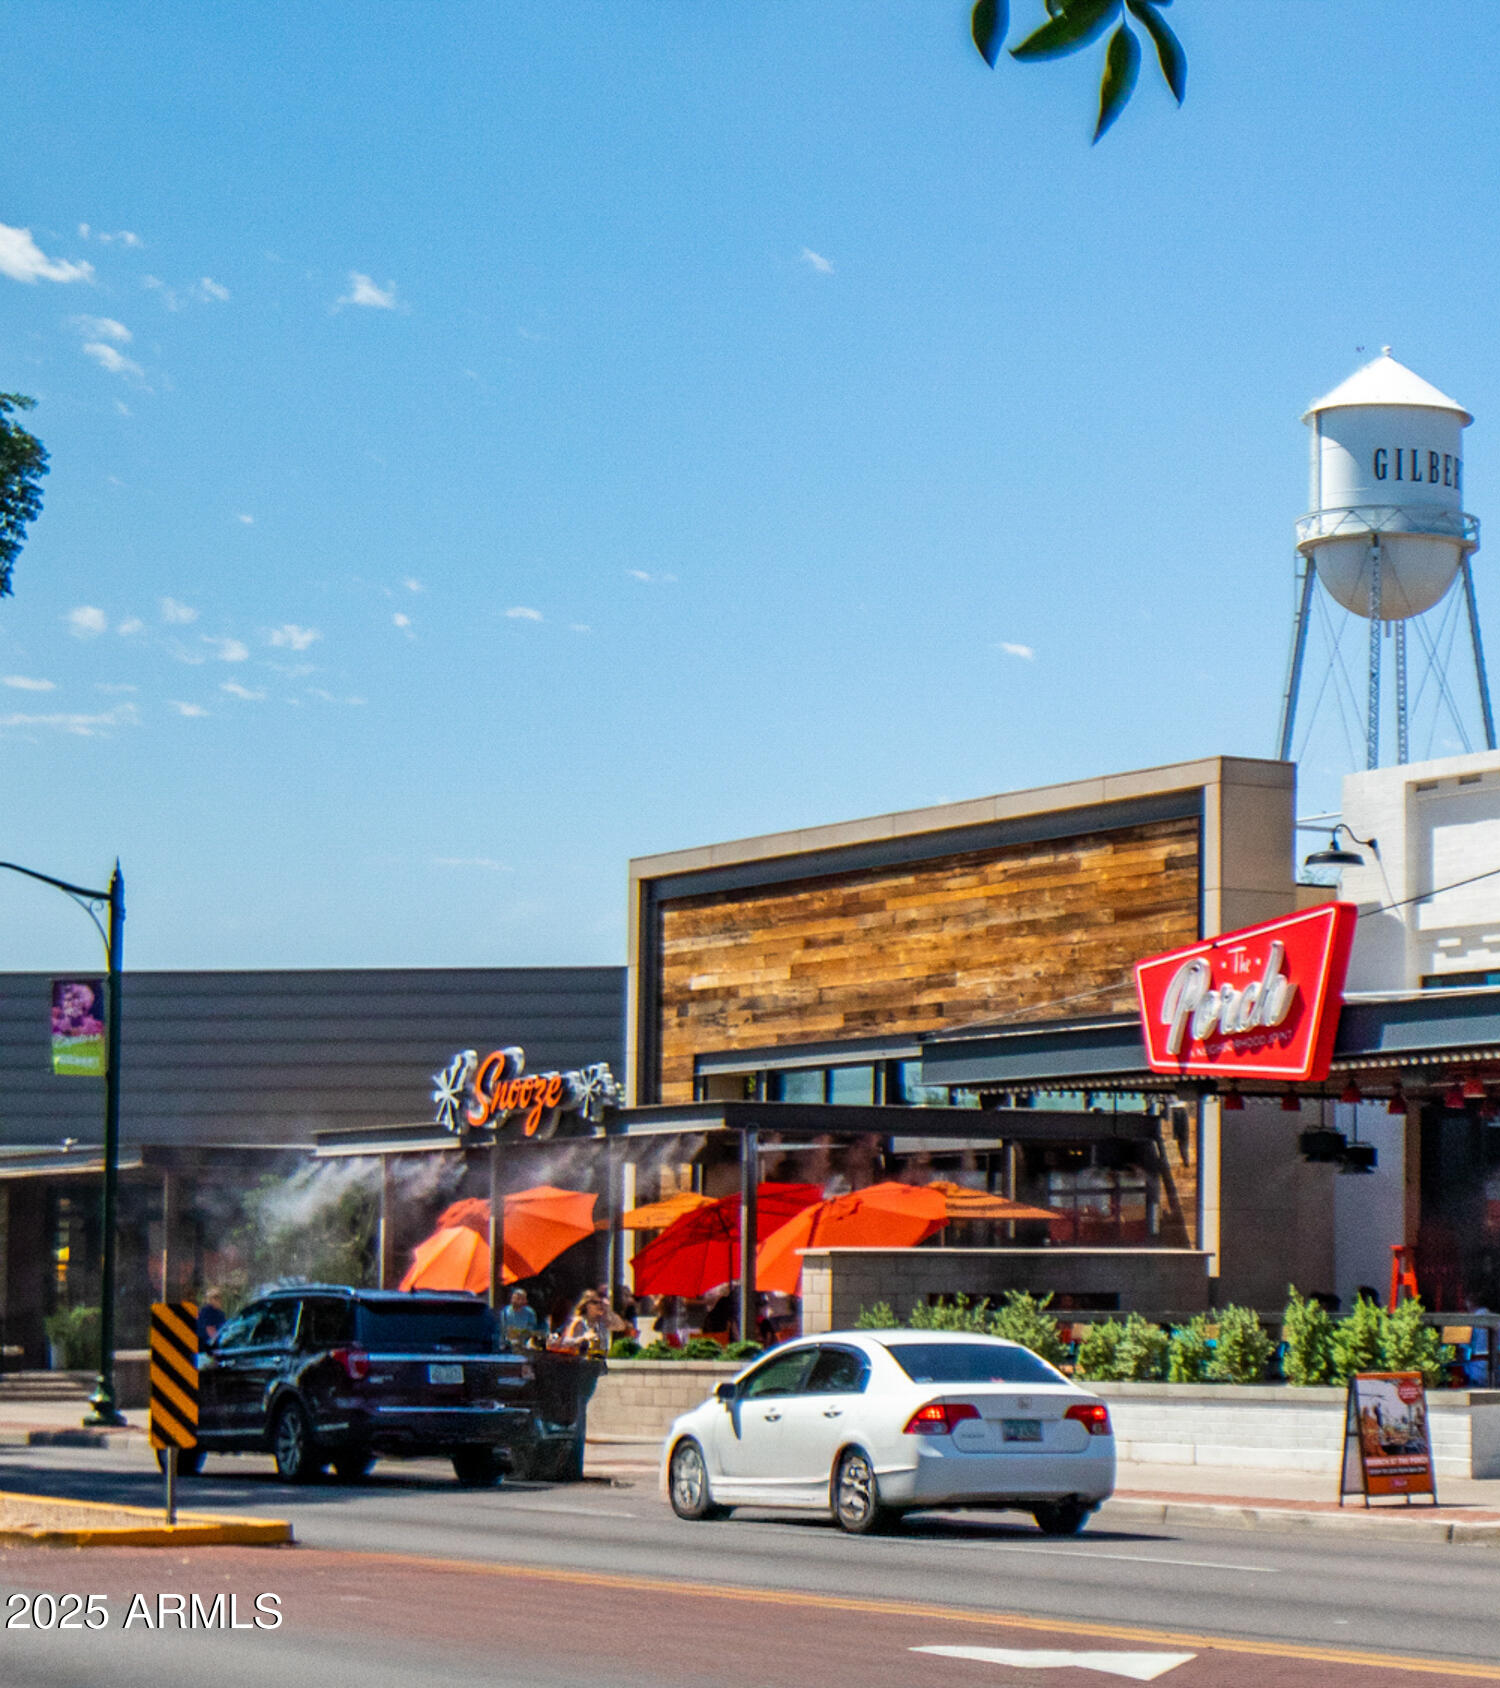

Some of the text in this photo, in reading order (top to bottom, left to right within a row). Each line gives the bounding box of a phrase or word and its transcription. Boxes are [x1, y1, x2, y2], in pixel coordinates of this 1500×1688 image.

[1161, 939, 1298, 1056] Porch
[1227, 946, 1252, 974] The
[467, 1050, 563, 1137] Snooze
